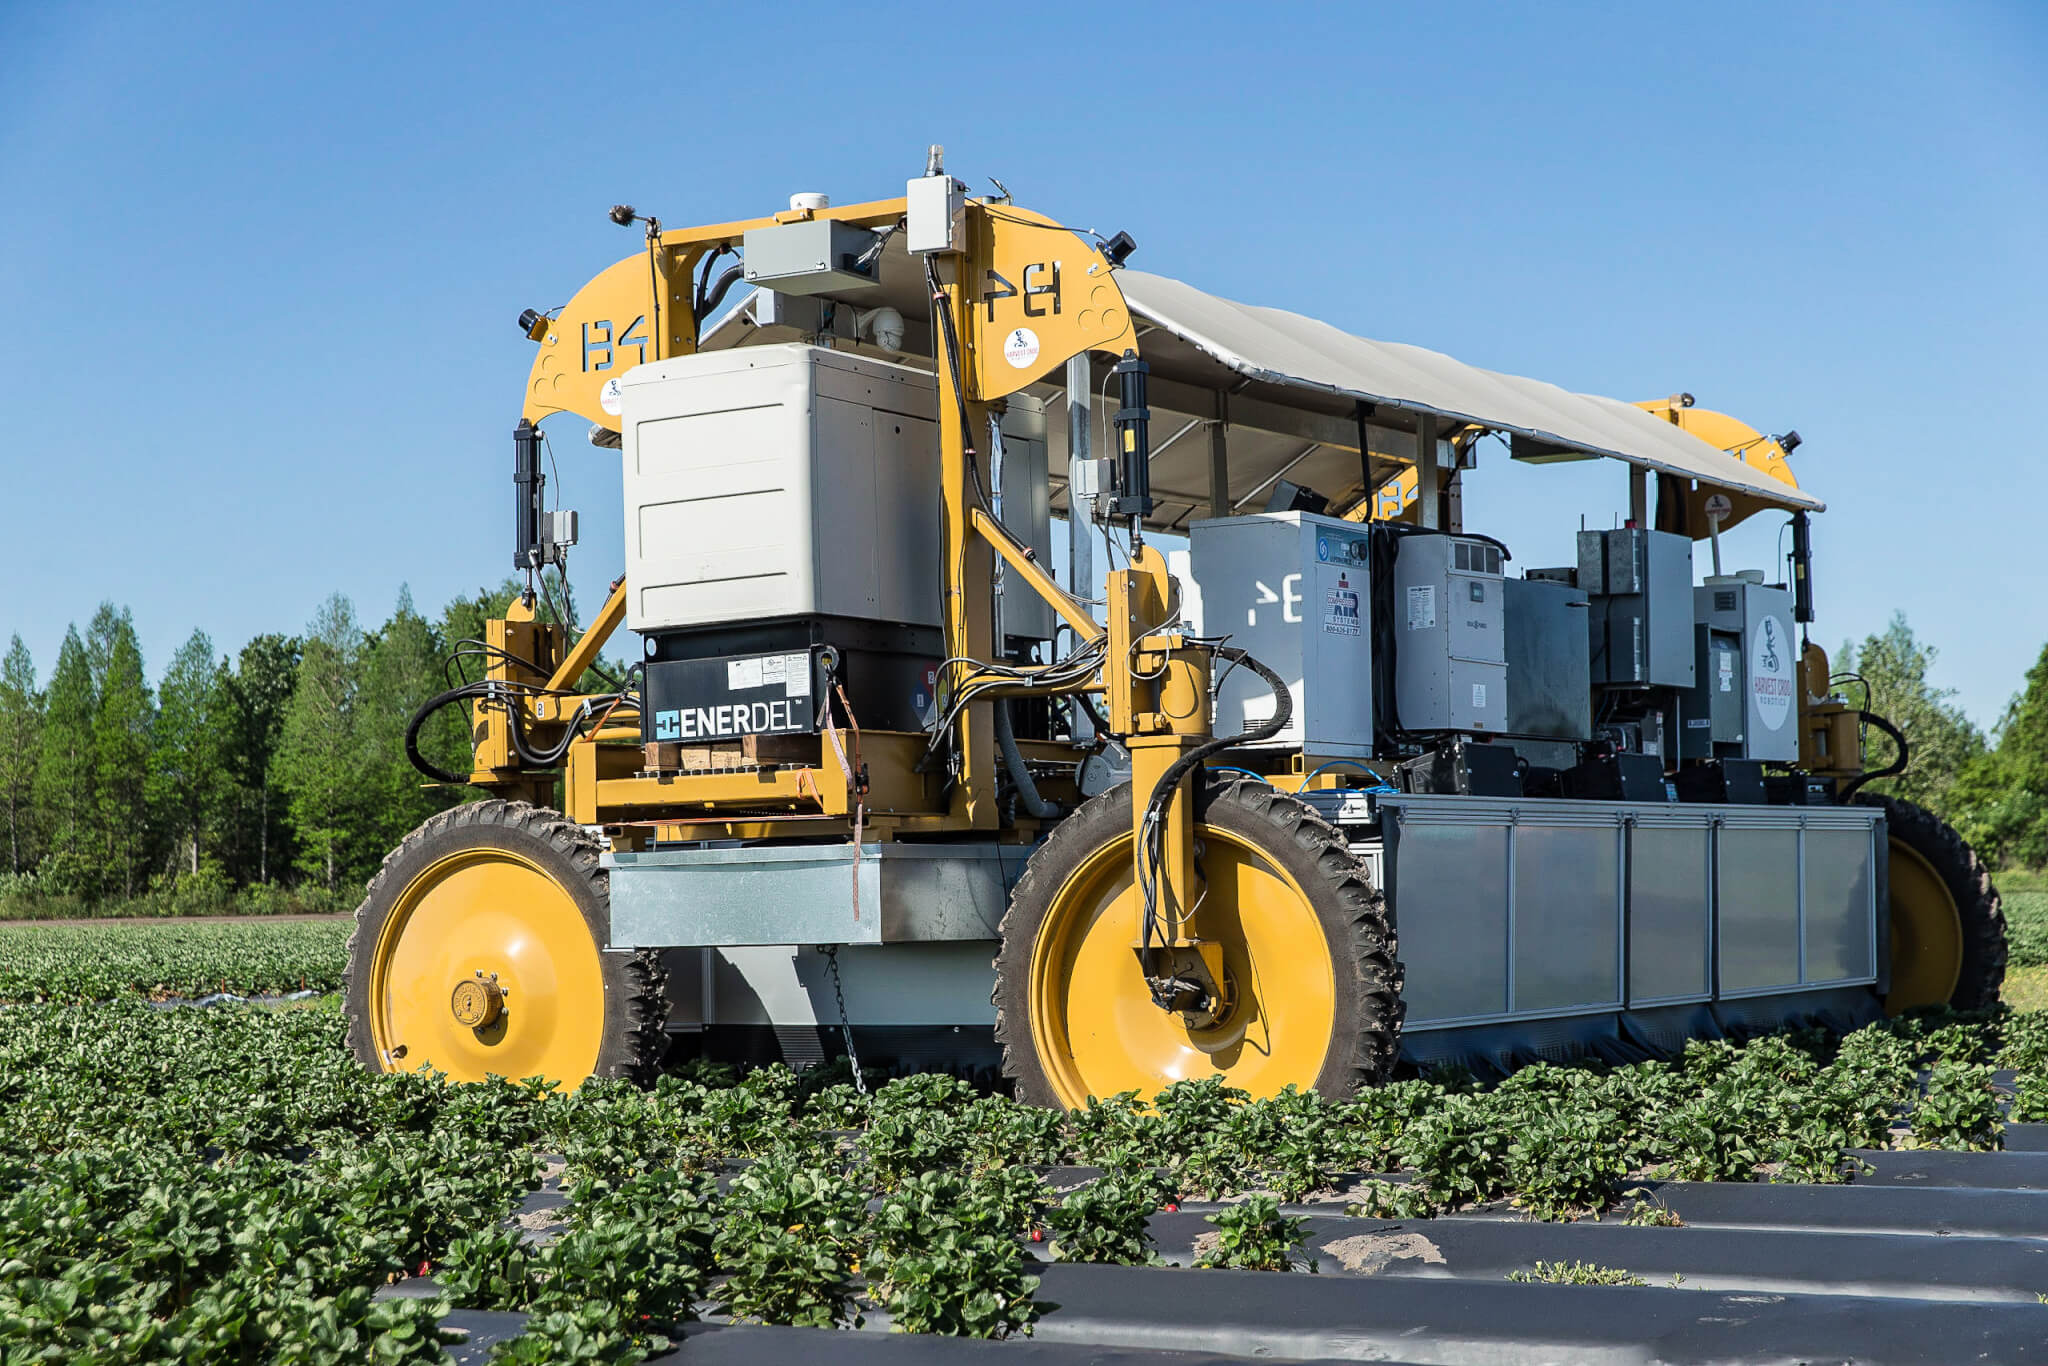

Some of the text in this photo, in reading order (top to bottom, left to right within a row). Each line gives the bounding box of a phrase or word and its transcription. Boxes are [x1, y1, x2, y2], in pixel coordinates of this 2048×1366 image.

[581, 315, 649, 373] B4
[1334, 590, 1359, 618] AIR
[1332, 615, 1359, 626] SYSTEMS
[1754, 676, 1777, 696] HARVEST
[680, 700, 803, 737] ENERDEL
